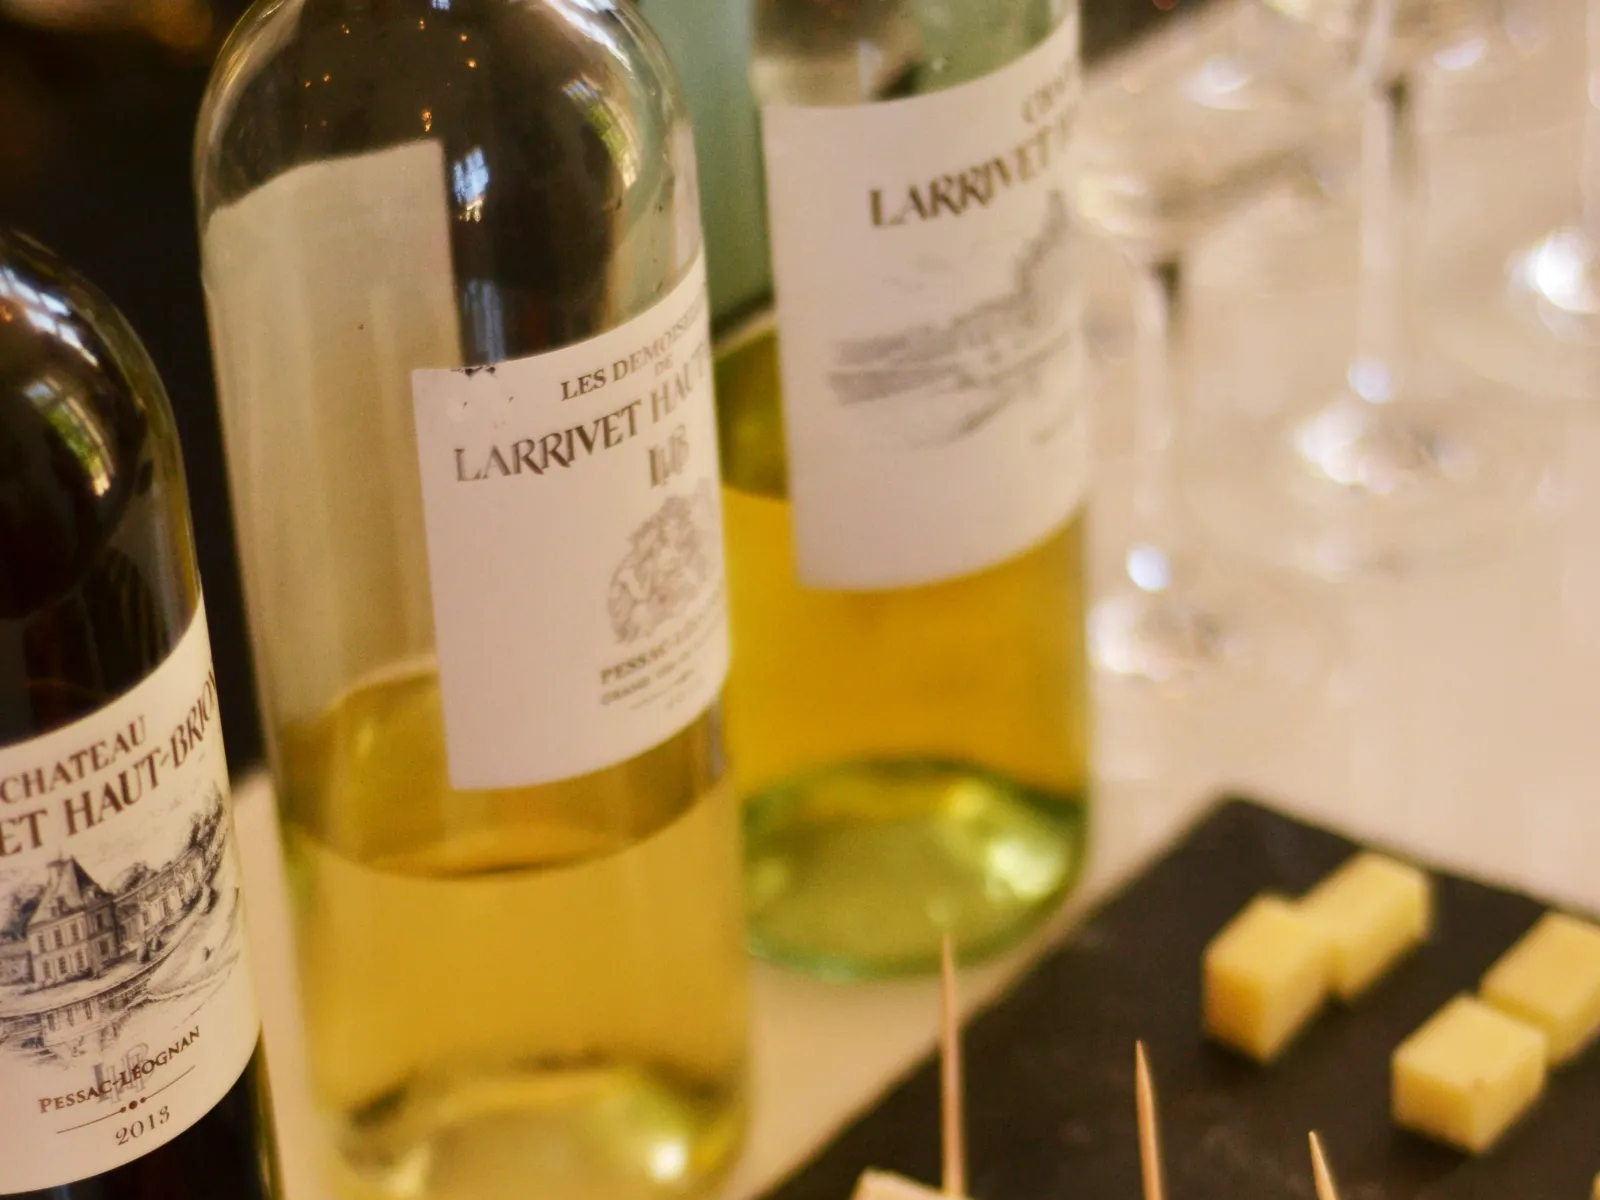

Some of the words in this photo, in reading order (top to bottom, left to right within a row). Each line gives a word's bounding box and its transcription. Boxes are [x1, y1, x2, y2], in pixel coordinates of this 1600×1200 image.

[560, 367, 608, 402] LES
[453, 398, 643, 482] LARRIVET
[0, 713, 146, 805] CHATEAU
[114, 1104, 171, 1147] 2013
